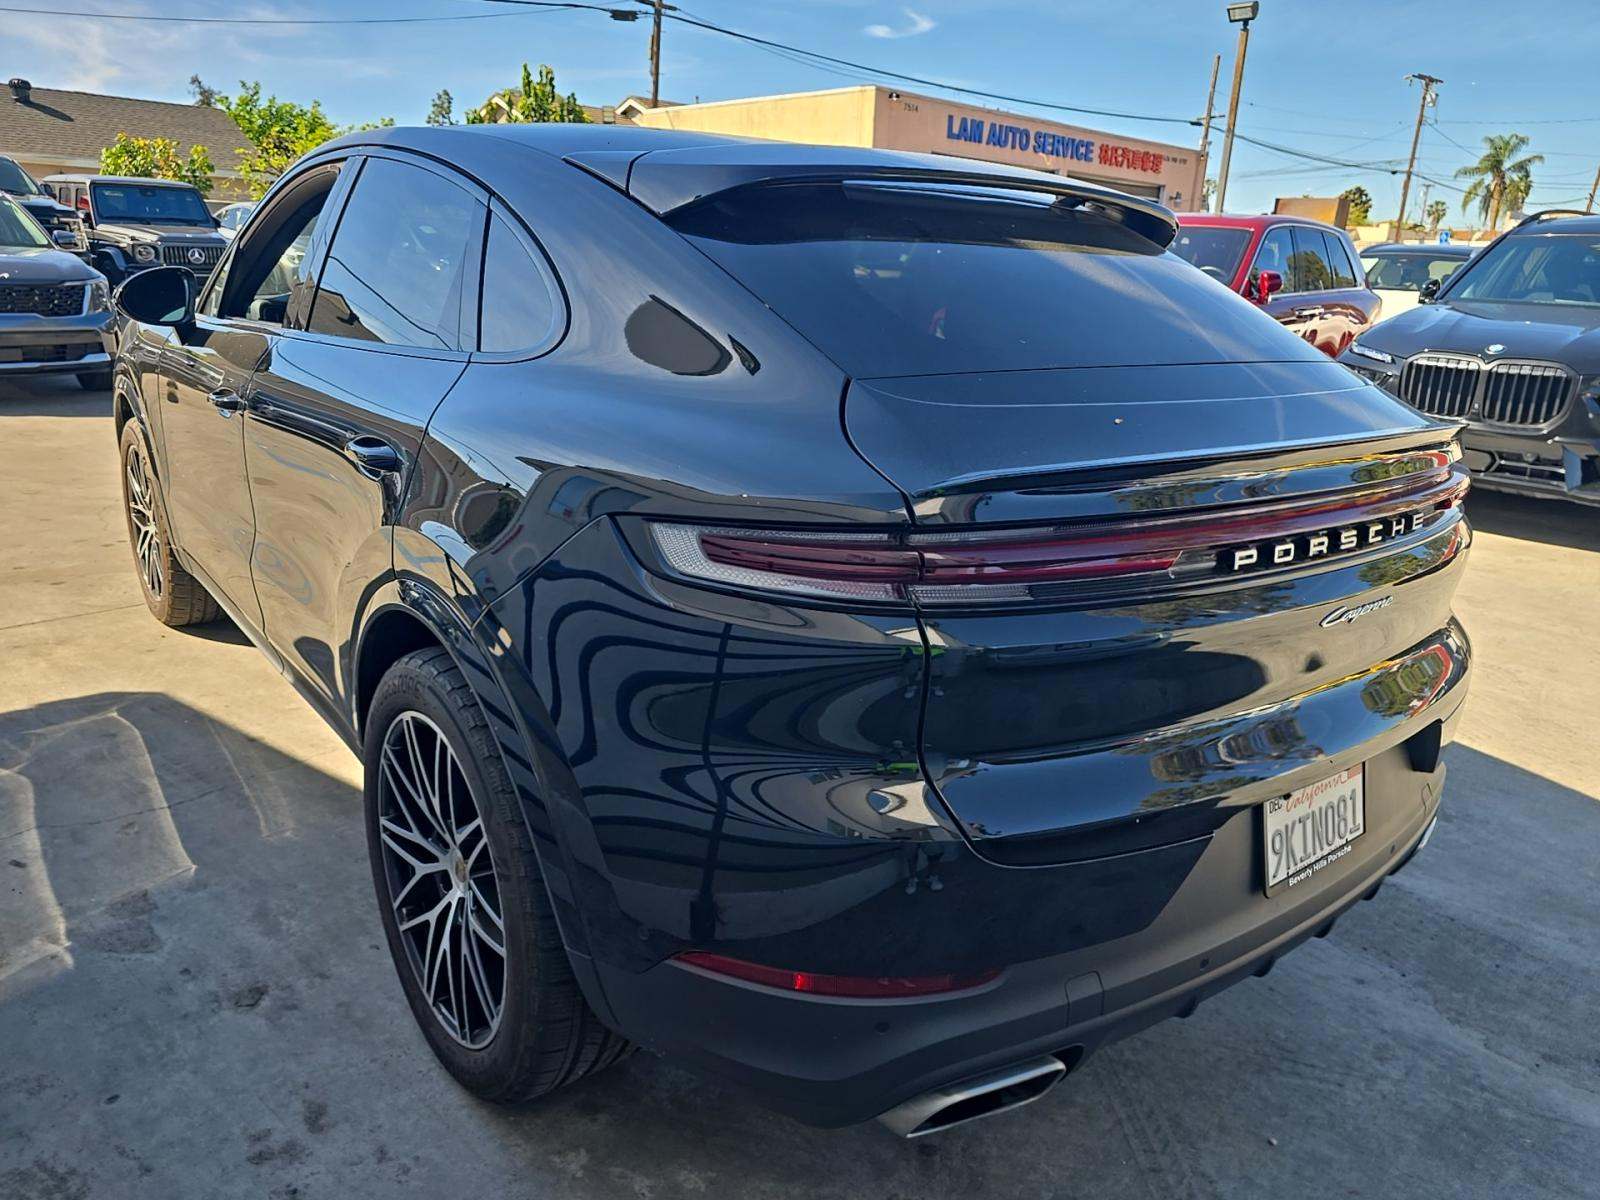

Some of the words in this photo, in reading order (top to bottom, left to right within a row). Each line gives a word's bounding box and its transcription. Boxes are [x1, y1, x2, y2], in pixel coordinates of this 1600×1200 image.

[947, 114, 984, 144] LAM
[986, 121, 1030, 151] AUTO
[1032, 130, 1094, 162] SERVICE
[1233, 512, 1425, 571] PORSCHE
[1319, 595, 1394, 628] Cayenne
[1271, 788, 1361, 879] 9KIN081
[1289, 866, 1313, 887] Beverly
[1313, 860, 1328, 873] Hills
[1327, 844, 1352, 864] Porsche
